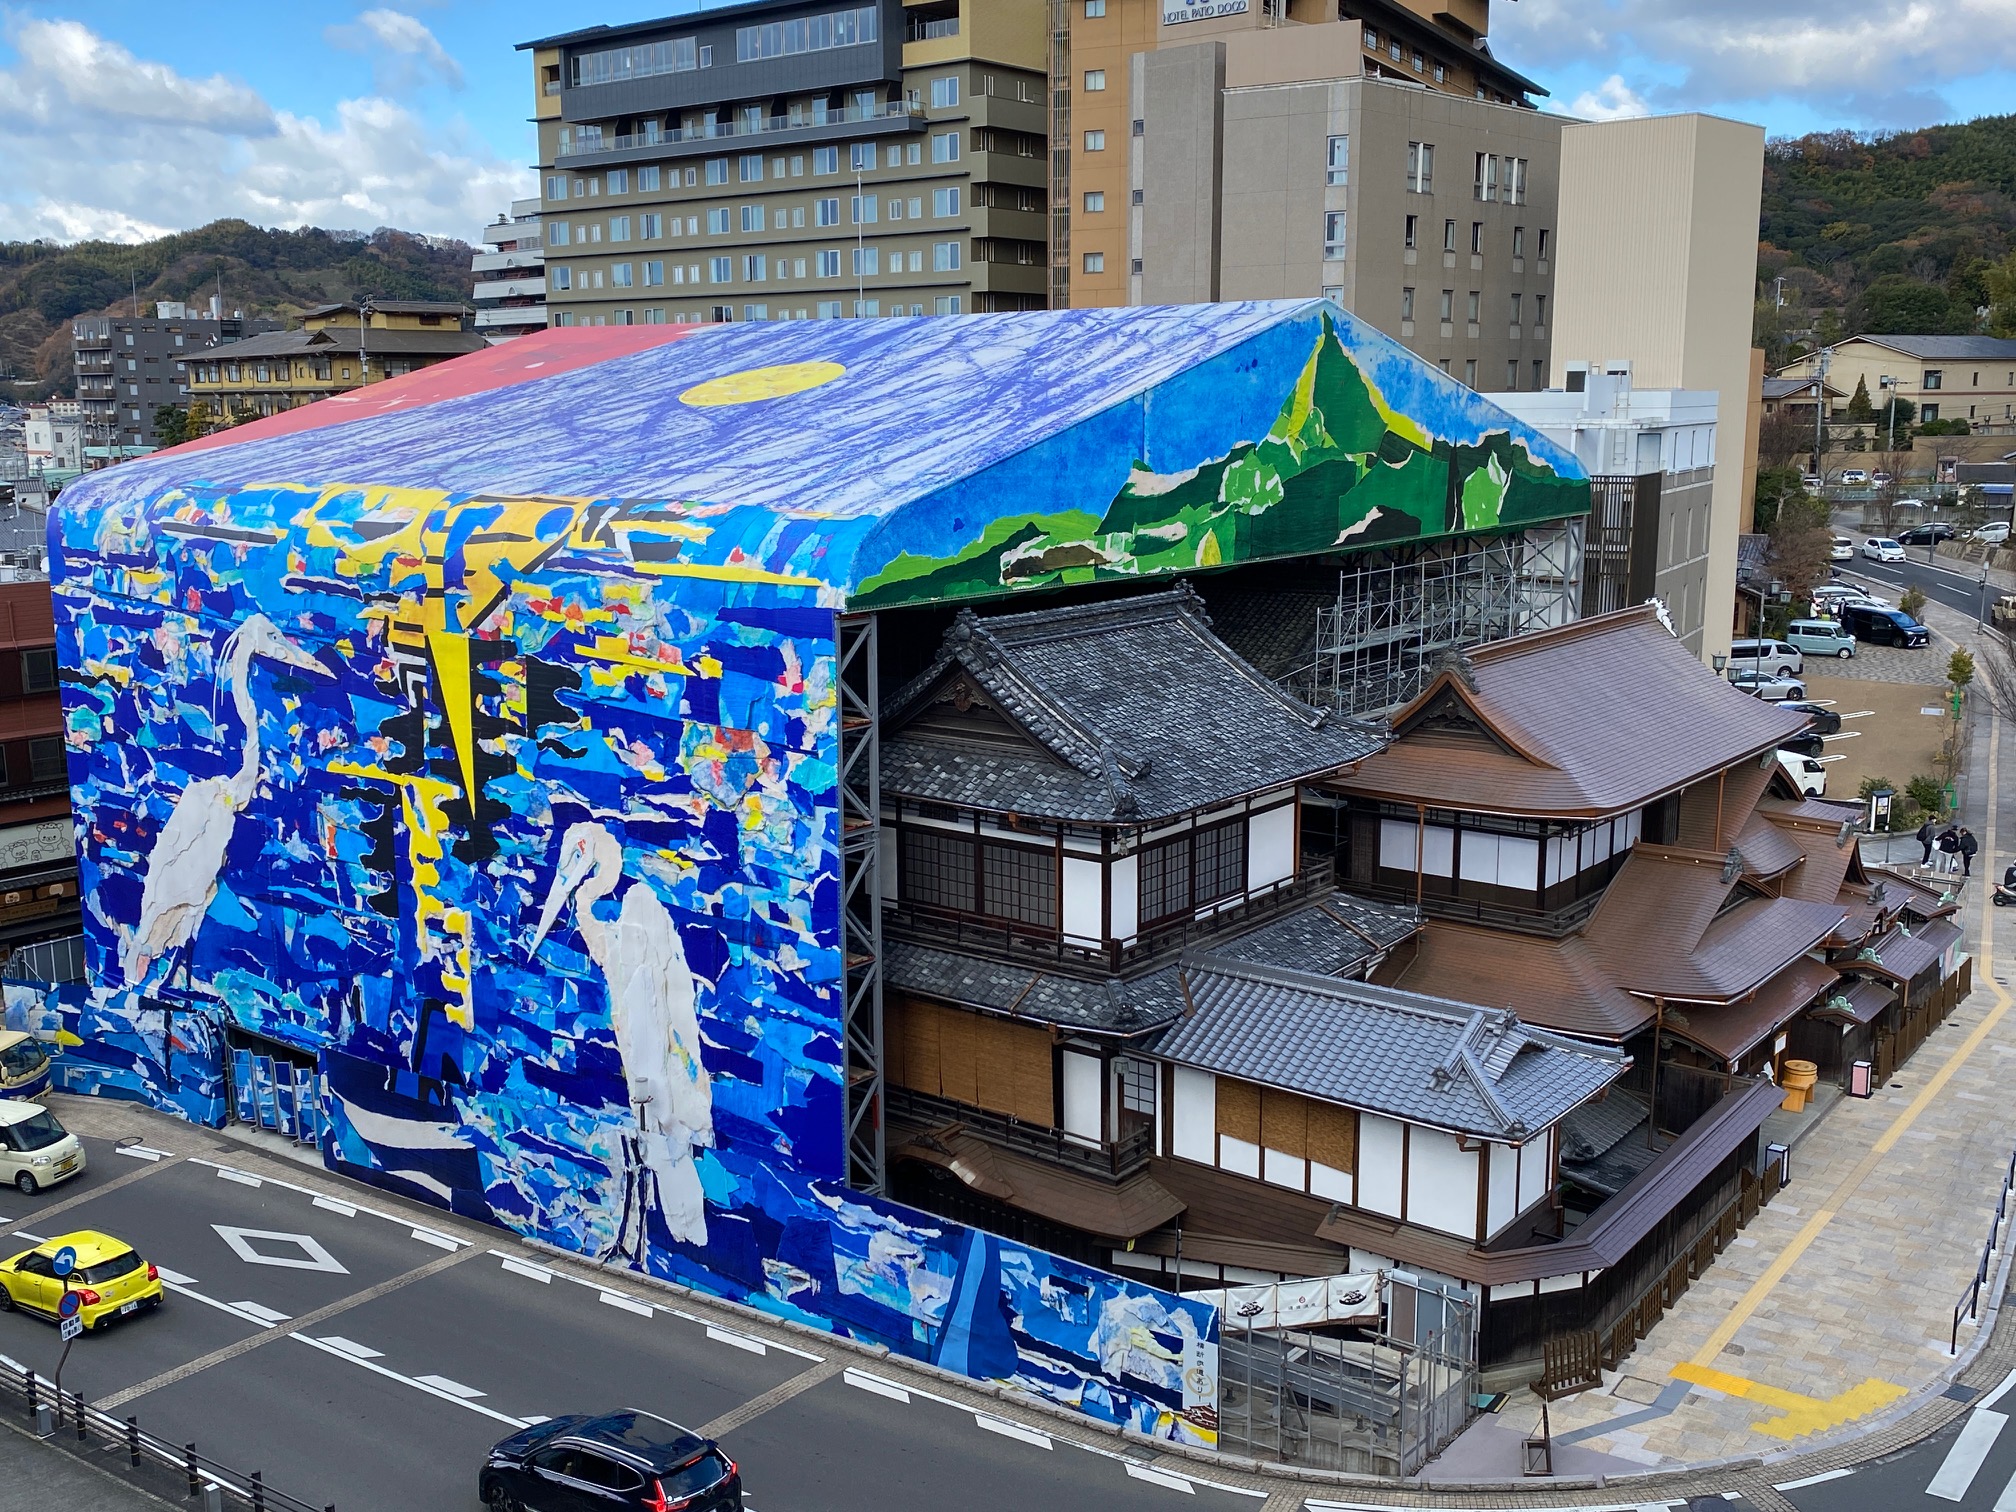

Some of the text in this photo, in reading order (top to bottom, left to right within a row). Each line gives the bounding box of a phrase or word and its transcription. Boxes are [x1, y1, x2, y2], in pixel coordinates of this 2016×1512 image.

[1163, 0, 1246, 23] HOTEL PATIO DOGO
